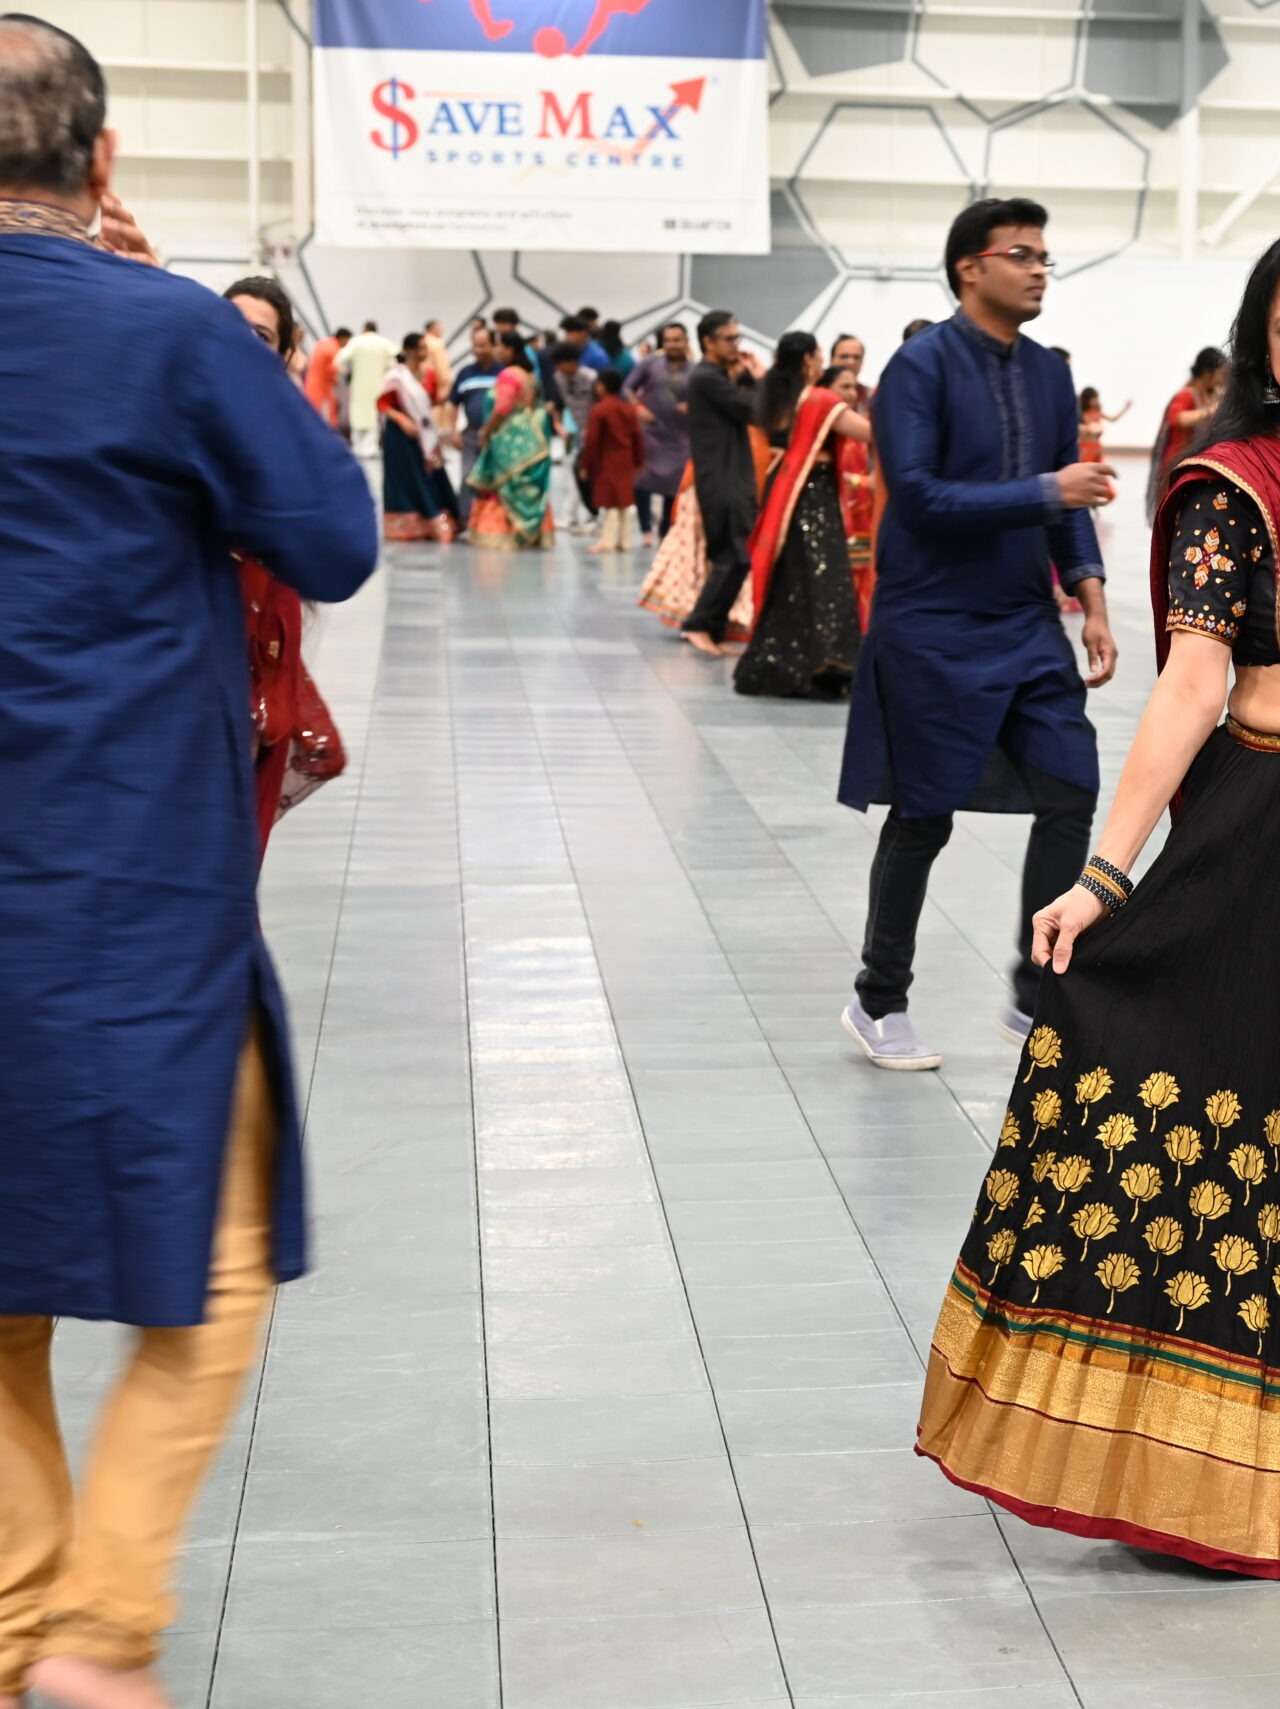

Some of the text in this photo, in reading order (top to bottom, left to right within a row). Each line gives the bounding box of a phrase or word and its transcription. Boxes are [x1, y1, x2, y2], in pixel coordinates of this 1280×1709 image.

[535, 89, 680, 140] MAX
[426, 150, 684, 168] SPORTS CENTRE
